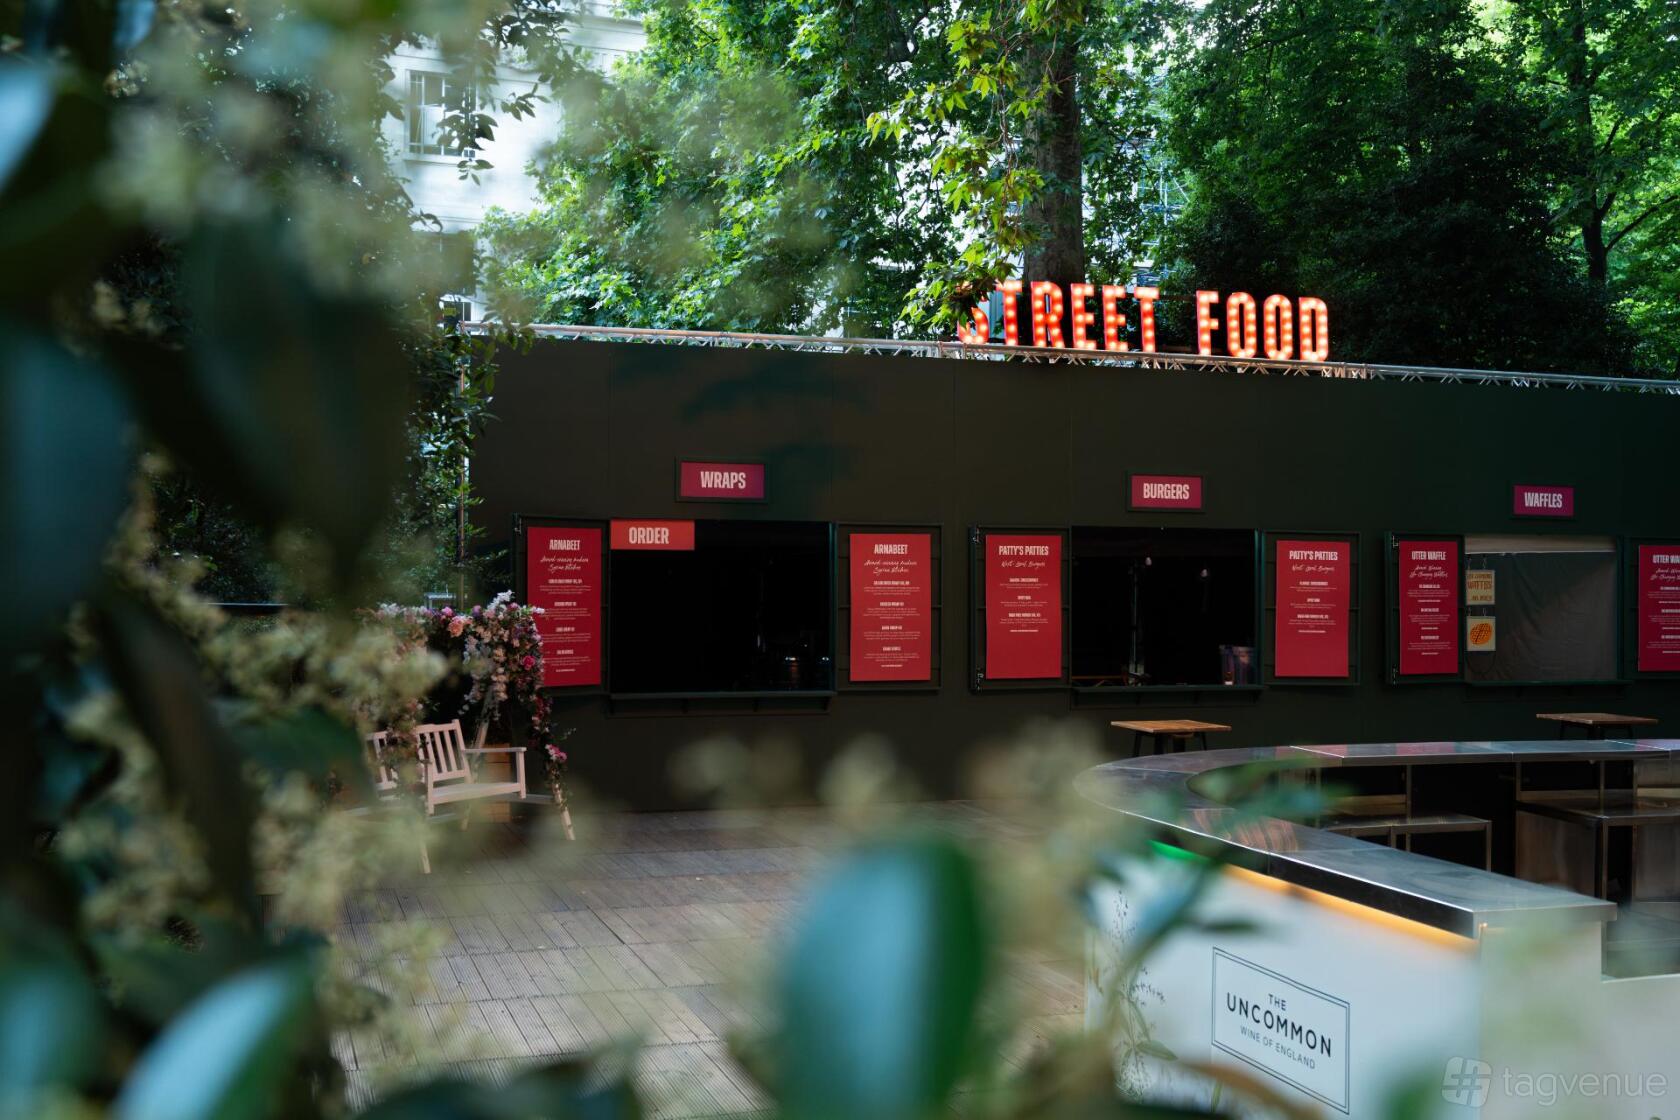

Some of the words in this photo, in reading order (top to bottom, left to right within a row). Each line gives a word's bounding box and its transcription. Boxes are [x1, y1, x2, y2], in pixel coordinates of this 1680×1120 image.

[1196, 290, 1329, 362] FOOD
[700, 471, 746, 489] WRAPS
[1143, 483, 1190, 500] BURGERS
[1524, 492, 1563, 508] WAFFLES
[628, 527, 670, 545] ORDER
[549, 539, 581, 551] ARNABEET
[874, 543, 908, 555] ARNABEET
[999, 545, 1024, 556] PATTY'S
[1025, 545, 1049, 556] PATTIES
[1289, 550, 1314, 560] PATTY'S
[1314, 551, 1338, 561] PATTIES
[1428, 551, 1446, 561] WAFFLE
[1652, 554, 1669, 564] UTTER
[1268, 993, 1287, 1011] THE
[1227, 992, 1331, 1058] UNCOMMON
[1240, 1025, 1260, 1043] WINE
[1262, 1036, 1273, 1048] OF
[1275, 1042, 1316, 1069] ENGLAND
